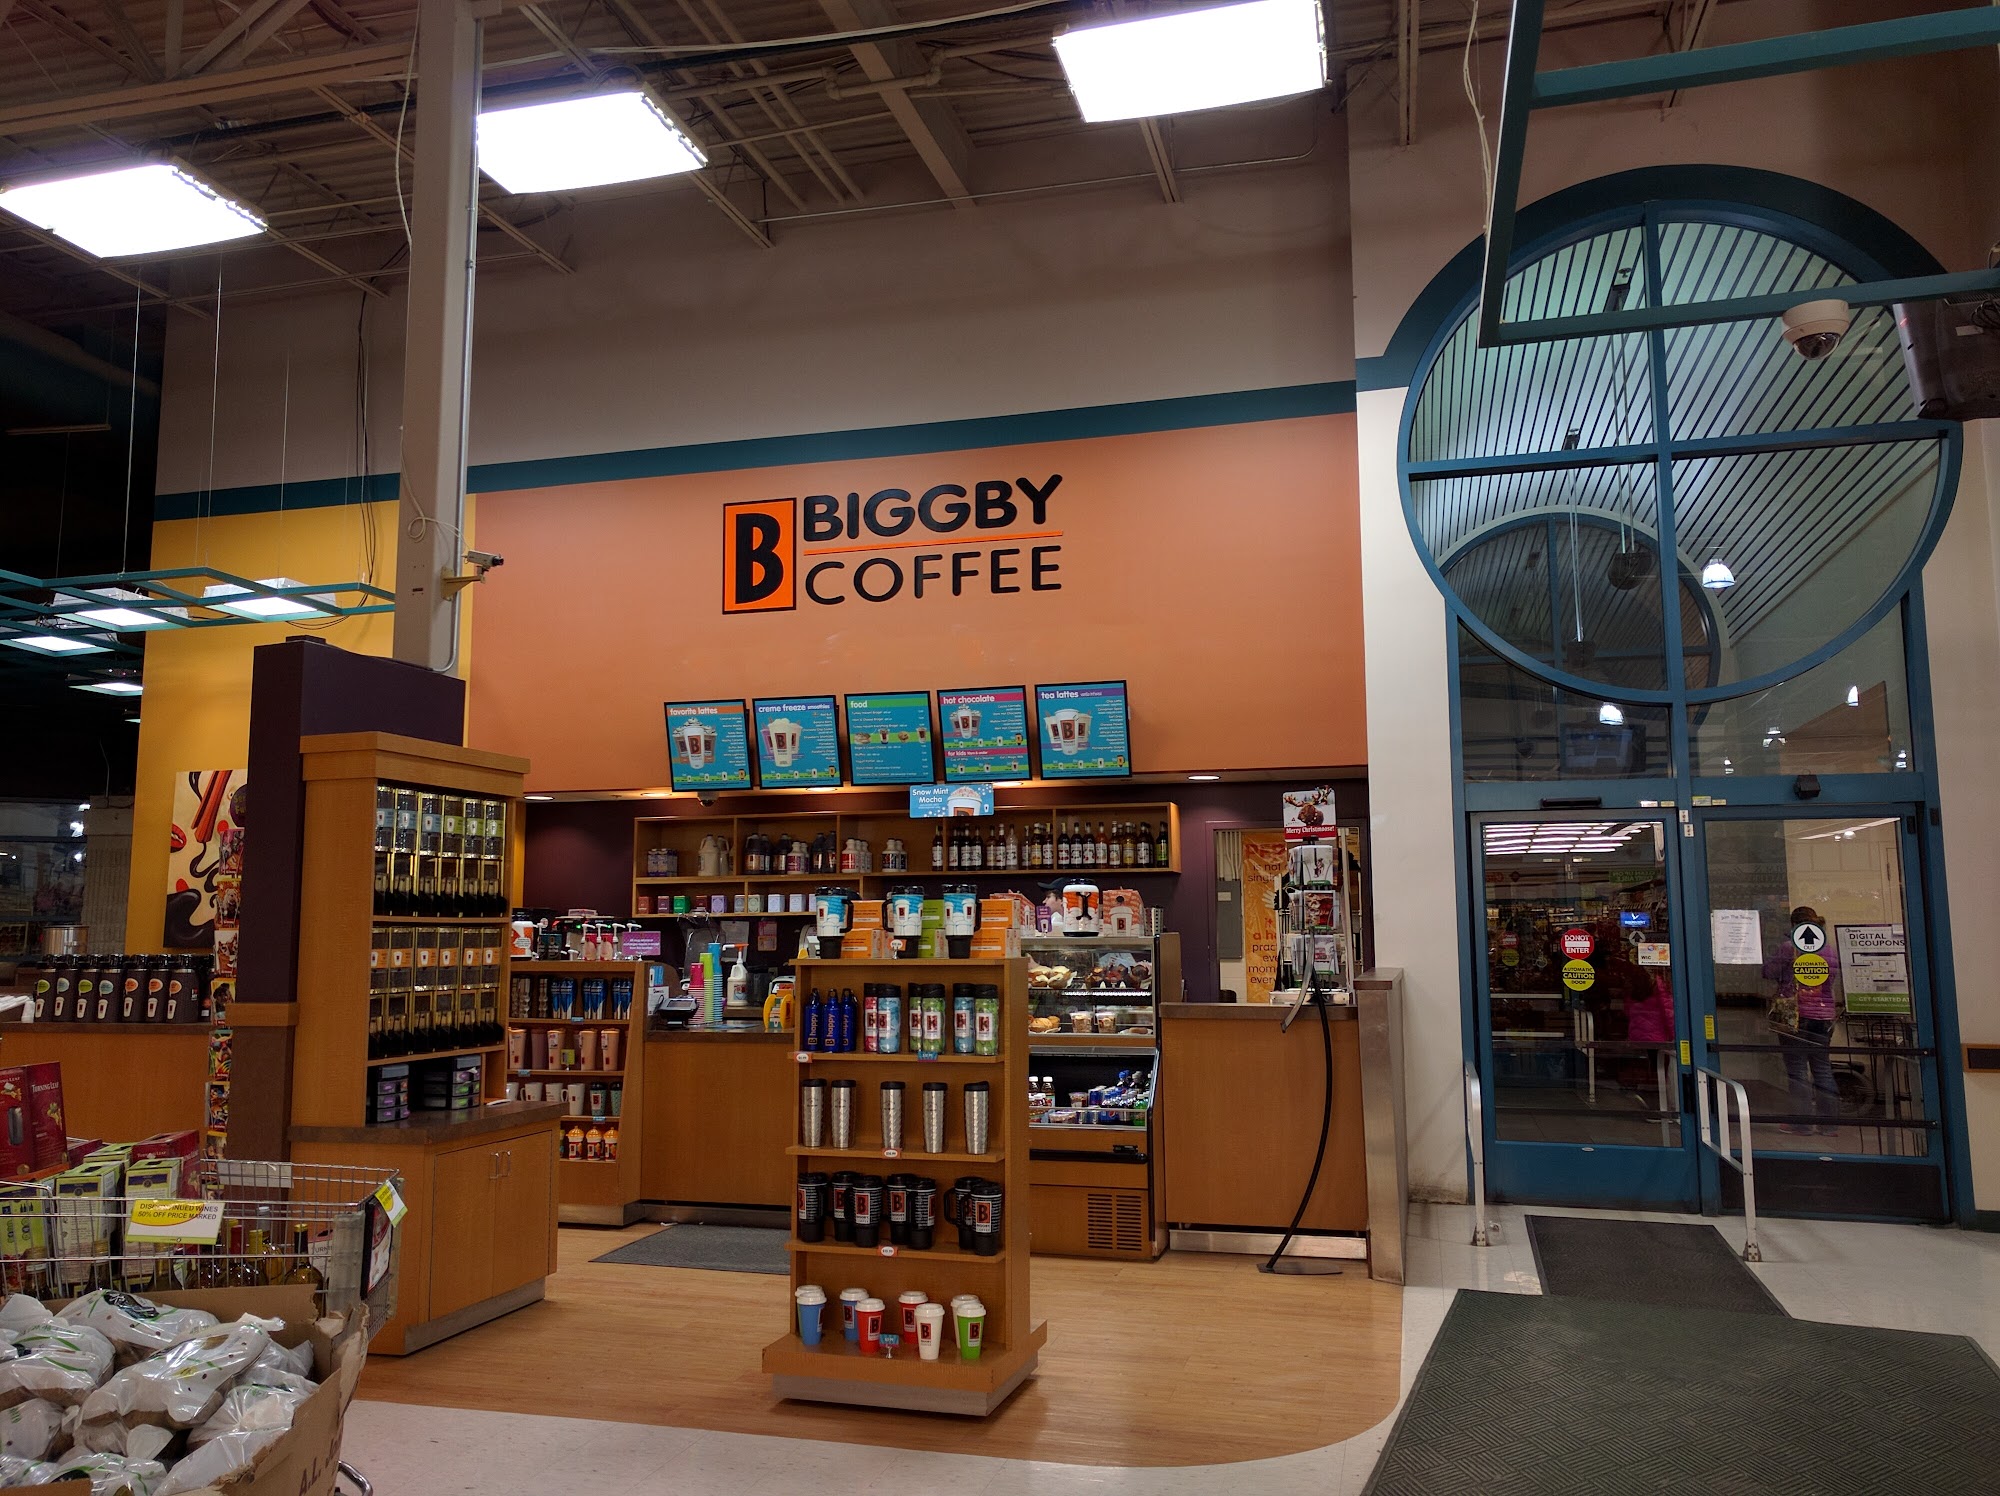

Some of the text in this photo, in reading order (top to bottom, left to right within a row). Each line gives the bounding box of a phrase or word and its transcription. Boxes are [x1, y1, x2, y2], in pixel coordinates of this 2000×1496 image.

[803, 474, 1064, 542] BIGGBY
[734, 512, 785, 605] B
[804, 545, 1063, 606] COFFEE
[957, 695, 995, 703] chocolate
[1041, 691, 1055, 699] tea
[1056, 690, 1079, 699] lattes
[782, 704, 806, 712] freeze
[850, 700, 868, 709] food
[670, 707, 718, 716] favorite lattes
[912, 787, 949, 796] Snow Mint
[918, 796, 943, 804] Mocha
[1286, 827, 1301, 835] Merry
[1264, 862, 1282, 871] not
[1253, 931, 1262, 941] a
[809, 1013, 819, 1036] happy
[827, 1014, 836, 1037] happy
